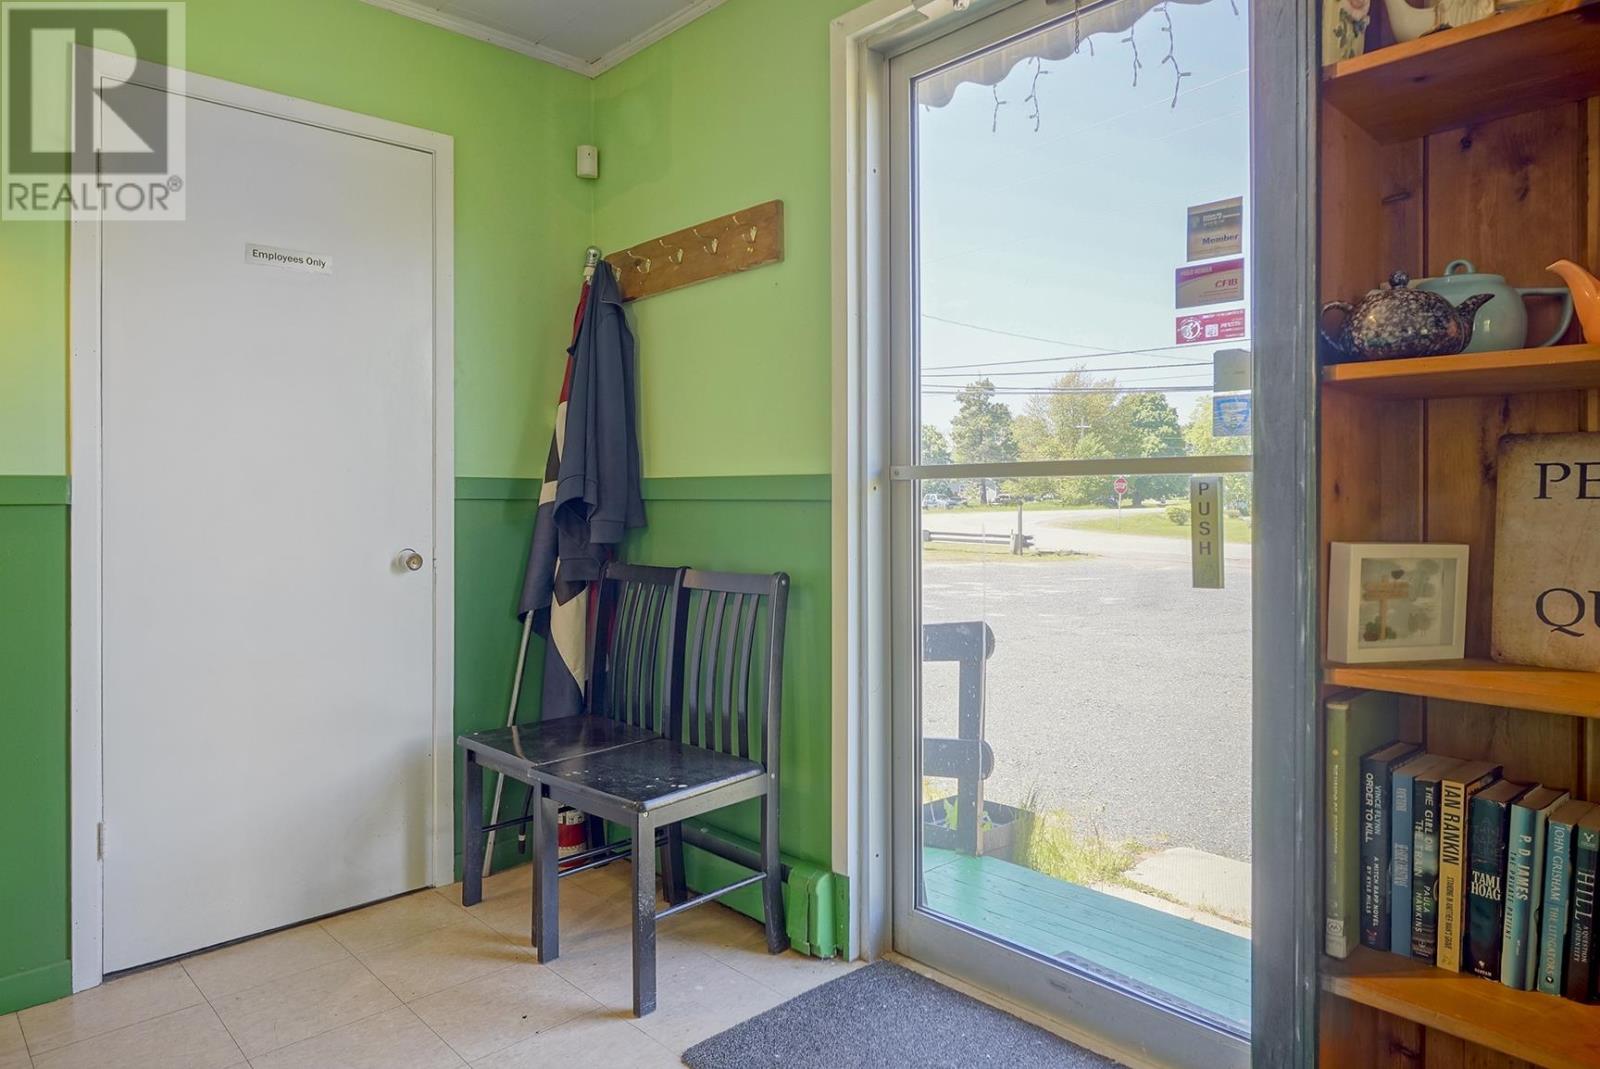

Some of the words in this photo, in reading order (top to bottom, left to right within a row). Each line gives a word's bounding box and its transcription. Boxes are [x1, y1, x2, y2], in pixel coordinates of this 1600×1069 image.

[1202, 233, 1239, 245] Member
[252, 248, 304, 265] Employees
[306, 255, 326, 269] Only
[1198, 482, 1212, 556] PUSH
[1365, 773, 1374, 805] ORDER
[1374, 784, 1382, 808] VINCE
[1424, 786, 1433, 806] THE
[1444, 784, 1461, 810] IAN
[1365, 808, 1374, 820] TO
[1374, 809, 1382, 835] FLYNN
[1424, 810, 1433, 834] GIRL
[1364, 821, 1373, 843] KILL
[1415, 819, 1424, 841] THE
[1442, 812, 1460, 866] RANKIN
[1554, 826, 1566, 854] JOHN
[1424, 836, 1433, 852] ON
[1414, 846, 1423, 878] TRAIN
[1471, 882, 1502, 900] HOAG
[1472, 870, 1500, 890] TAMI
[1507, 870, 1516, 904] PRIVATE
[1516, 864, 1530, 901] JAMES
[1551, 855, 1564, 901] GRISHAM
[1423, 884, 1431, 913] PAULA
[1574, 870, 1596, 921] HILL
[1414, 891, 1423, 934] HAWKINS
[1505, 906, 1514, 940] PATIENT
[1548, 906, 1559, 922] THE
[1546, 924, 1558, 976] LITIGATORS
[1580, 930, 1588, 963] QUESTION
